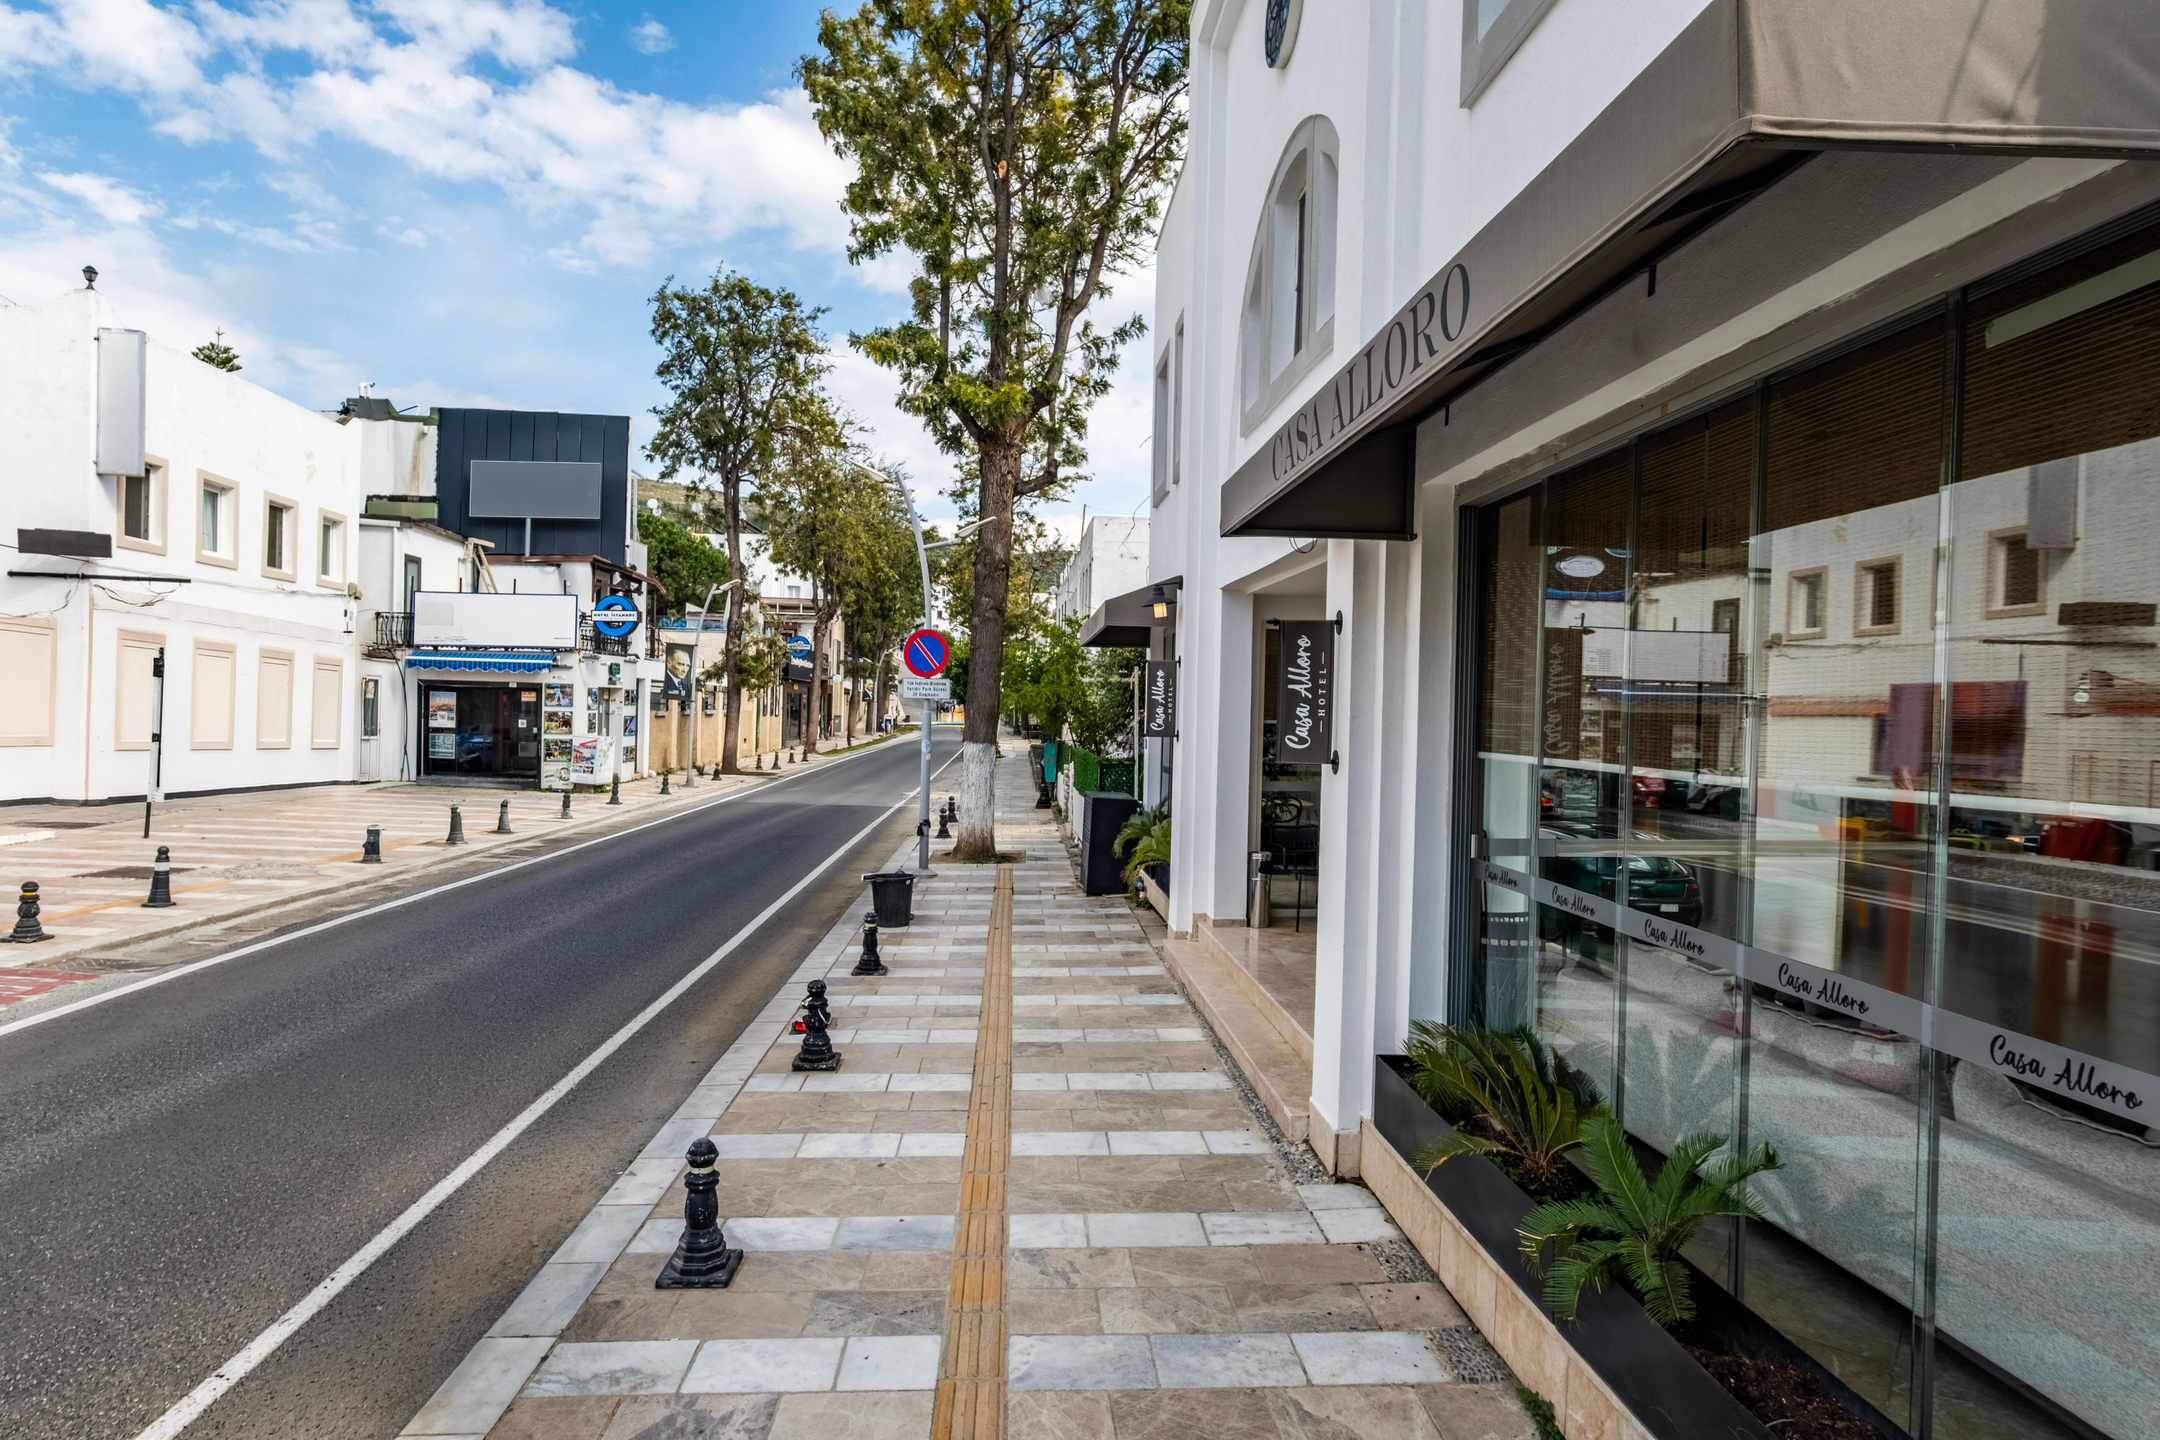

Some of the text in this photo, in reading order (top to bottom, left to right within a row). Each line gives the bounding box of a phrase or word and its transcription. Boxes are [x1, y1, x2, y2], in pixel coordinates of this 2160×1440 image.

[1272, 262, 1471, 482] CASA ALLORO
[1150, 669, 1166, 731] Casa Alloro
[1284, 634, 1313, 750] Casa Alloro
[1317, 668, 1327, 717] HOTEL
[1484, 864, 1518, 888] Casa Alloro
[1551, 885, 1596, 917] Casa Alloro
[1643, 918, 1706, 956] Casa Alloro
[1777, 962, 1870, 1015] Casa Alloro
[1989, 1034, 2143, 1110] Casa Alloro
